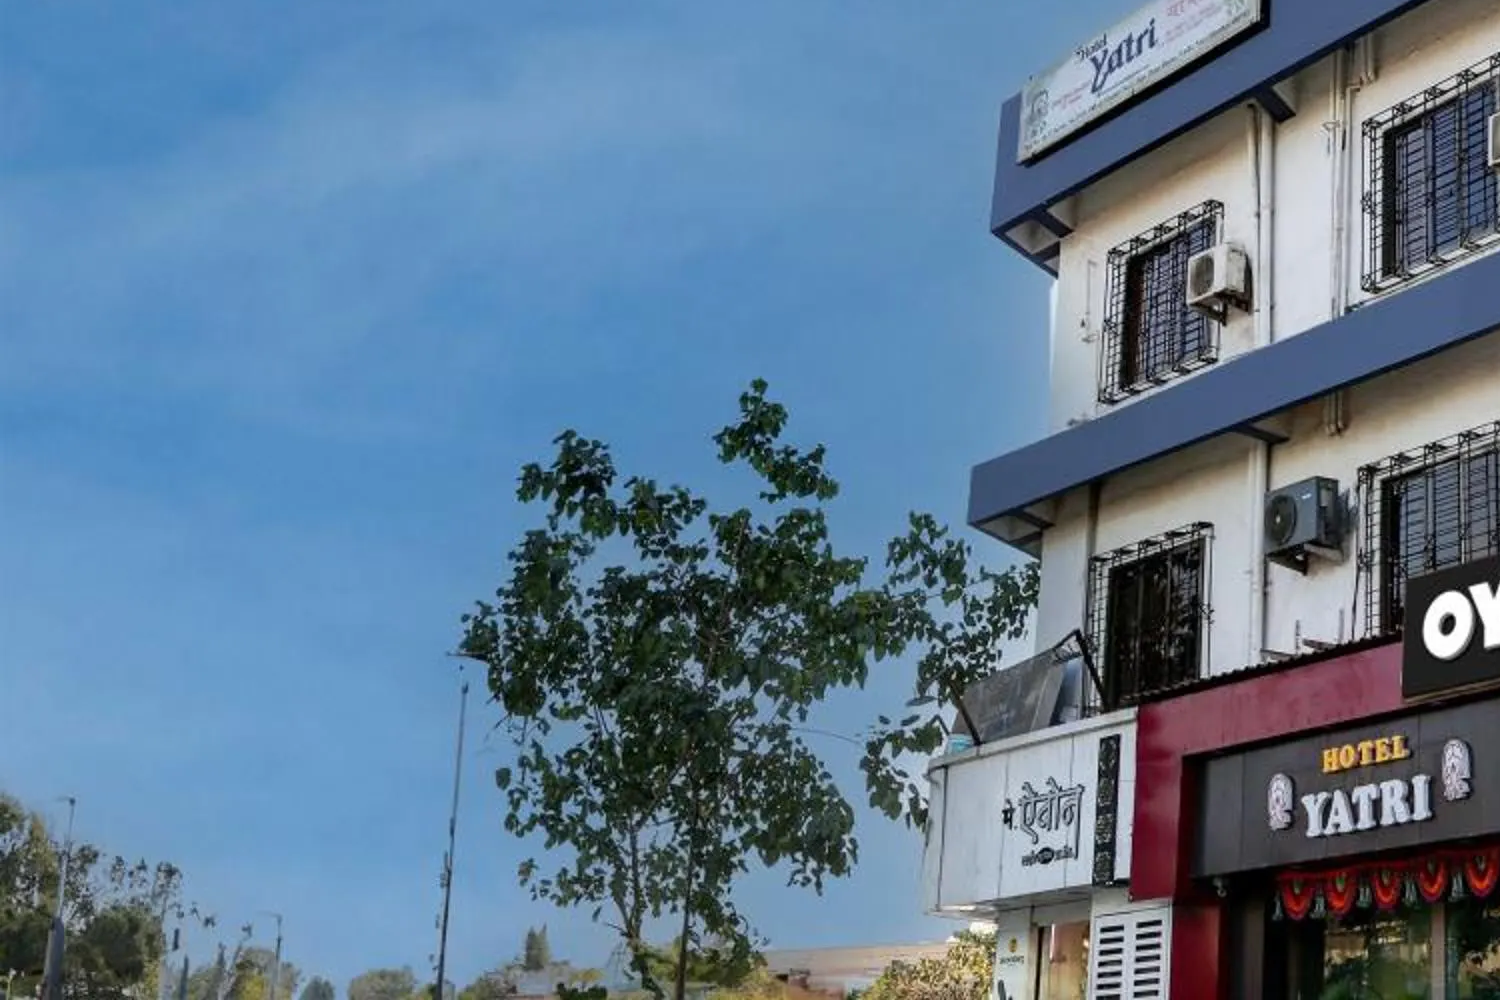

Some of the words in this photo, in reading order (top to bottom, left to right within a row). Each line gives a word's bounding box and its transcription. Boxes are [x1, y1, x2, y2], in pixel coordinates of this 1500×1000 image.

[1089, 17, 1156, 94] Yatri
[1322, 735, 1411, 774] HOTEL
[1301, 773, 1433, 837] YATRI
